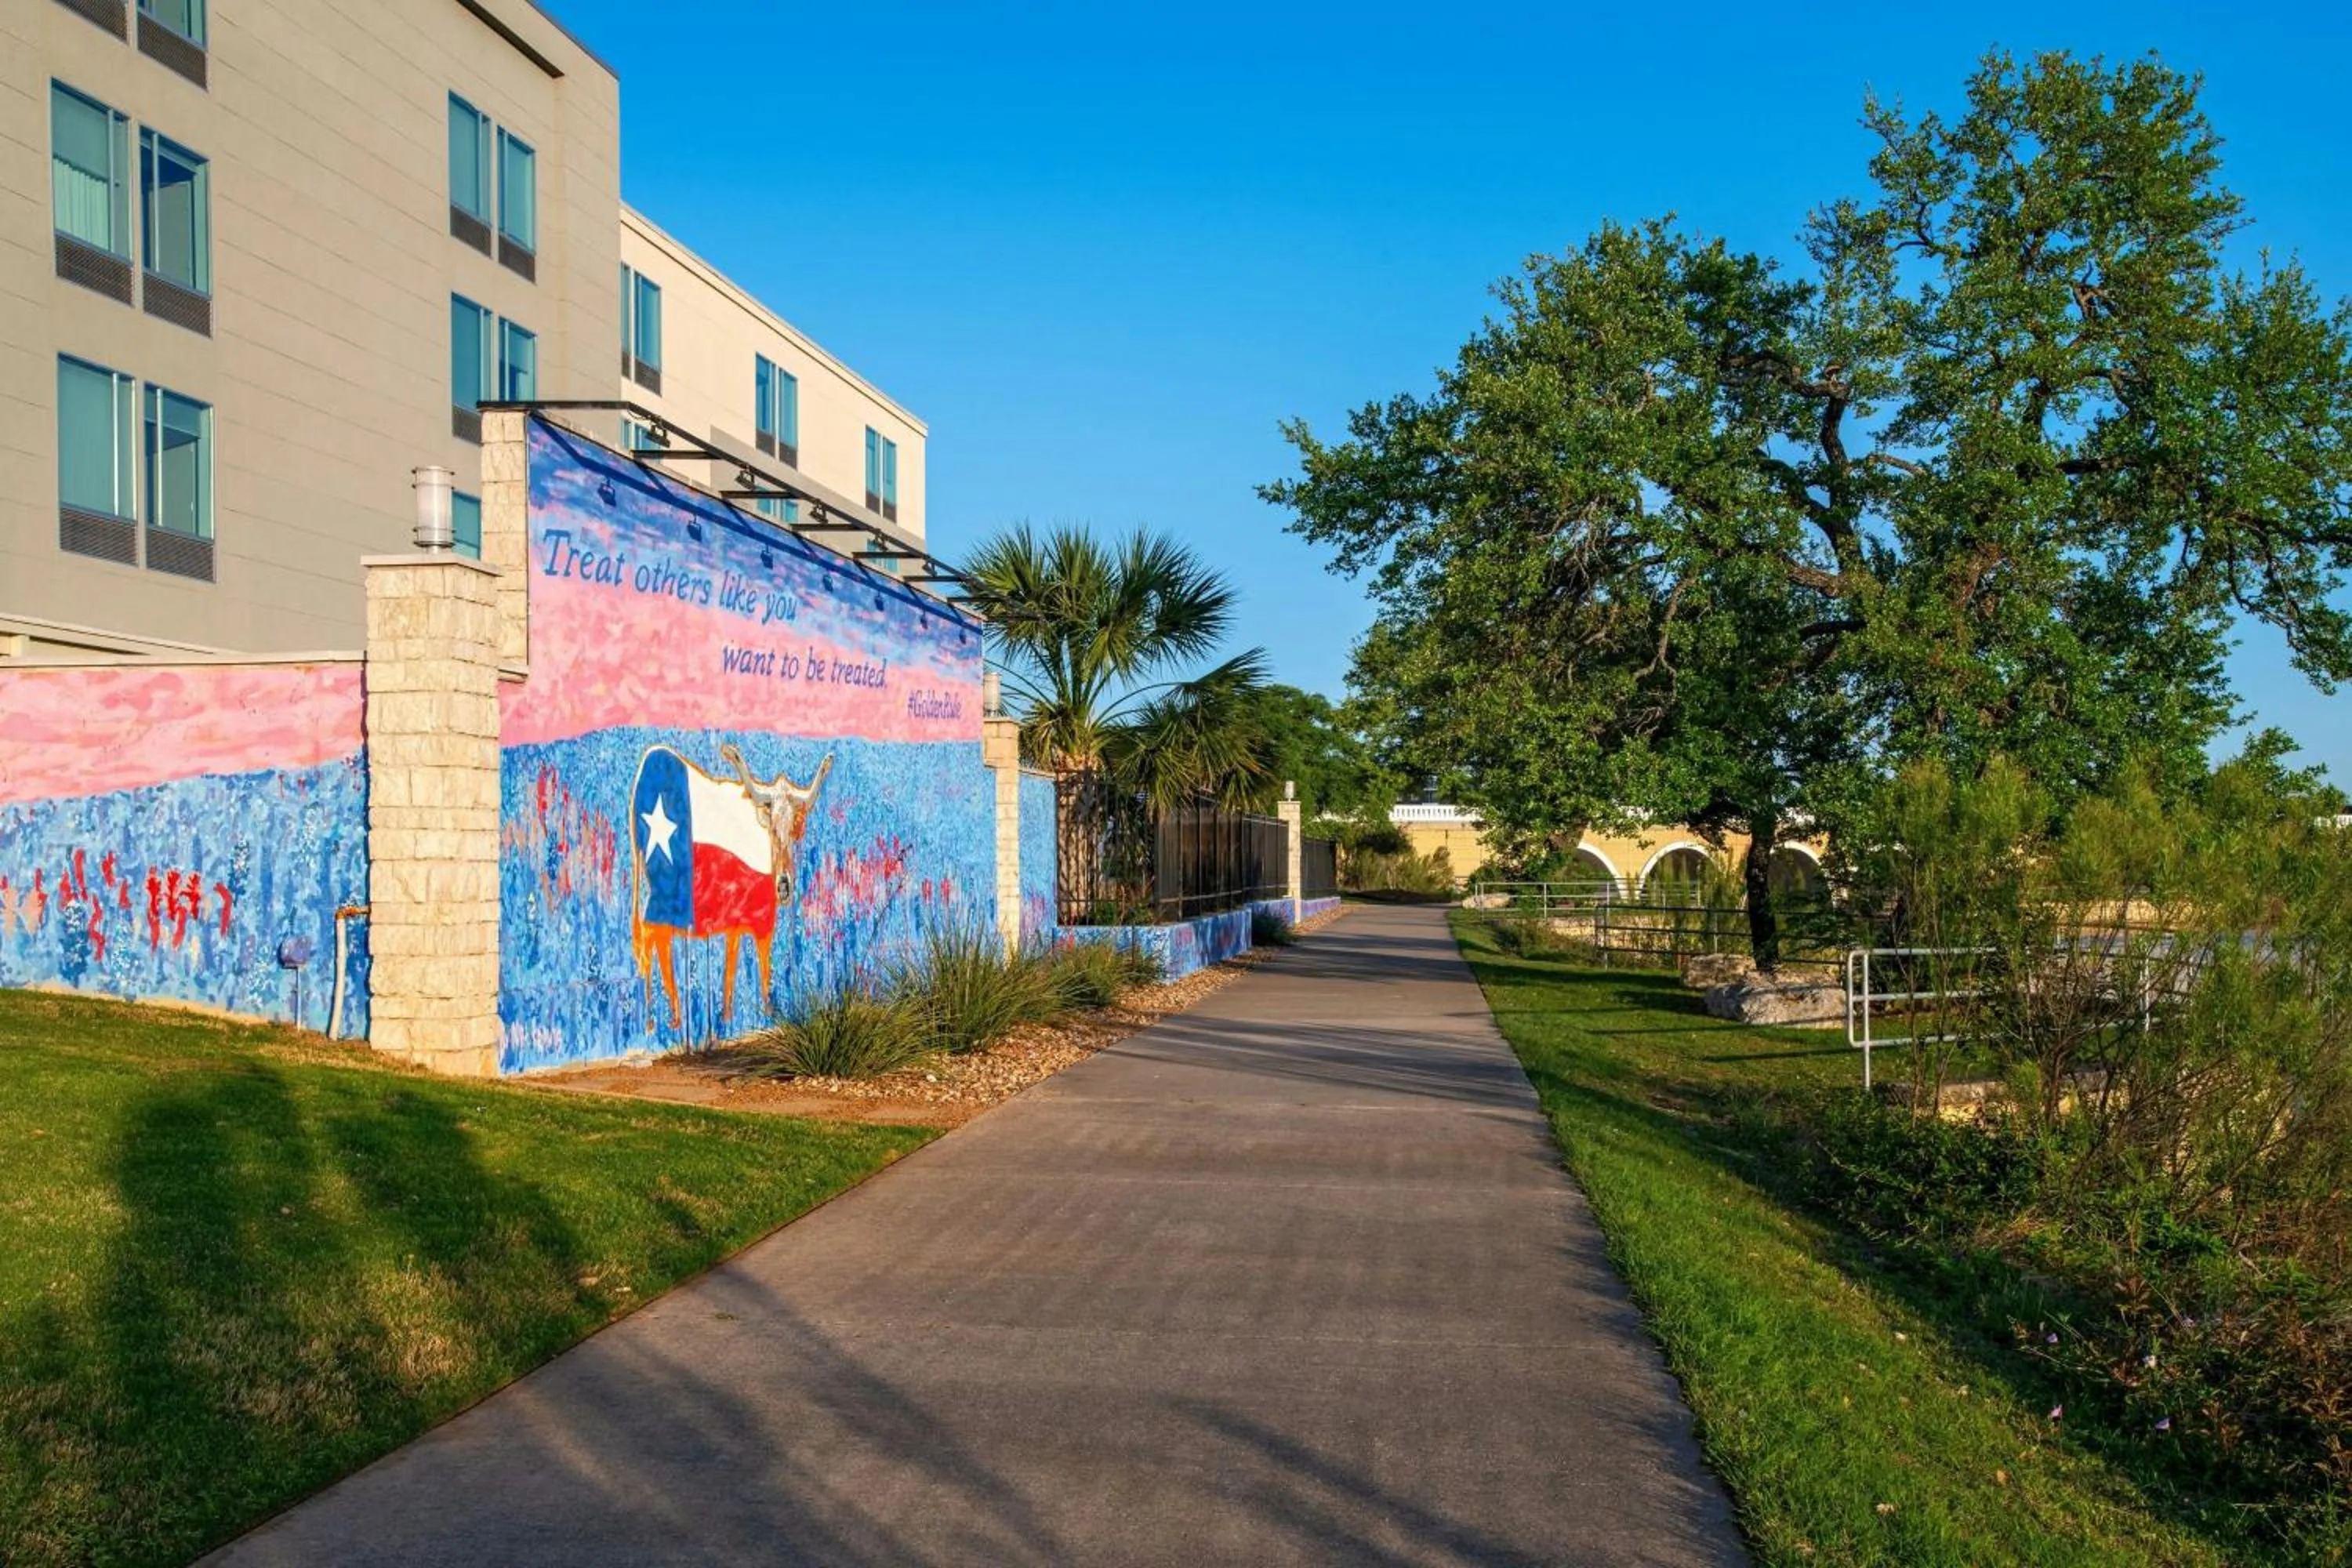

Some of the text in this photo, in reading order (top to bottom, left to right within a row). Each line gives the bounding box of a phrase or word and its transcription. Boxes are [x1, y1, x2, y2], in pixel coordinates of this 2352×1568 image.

[543, 528, 797, 624] Treat others like you
[723, 645, 887, 688] want to be treated.
